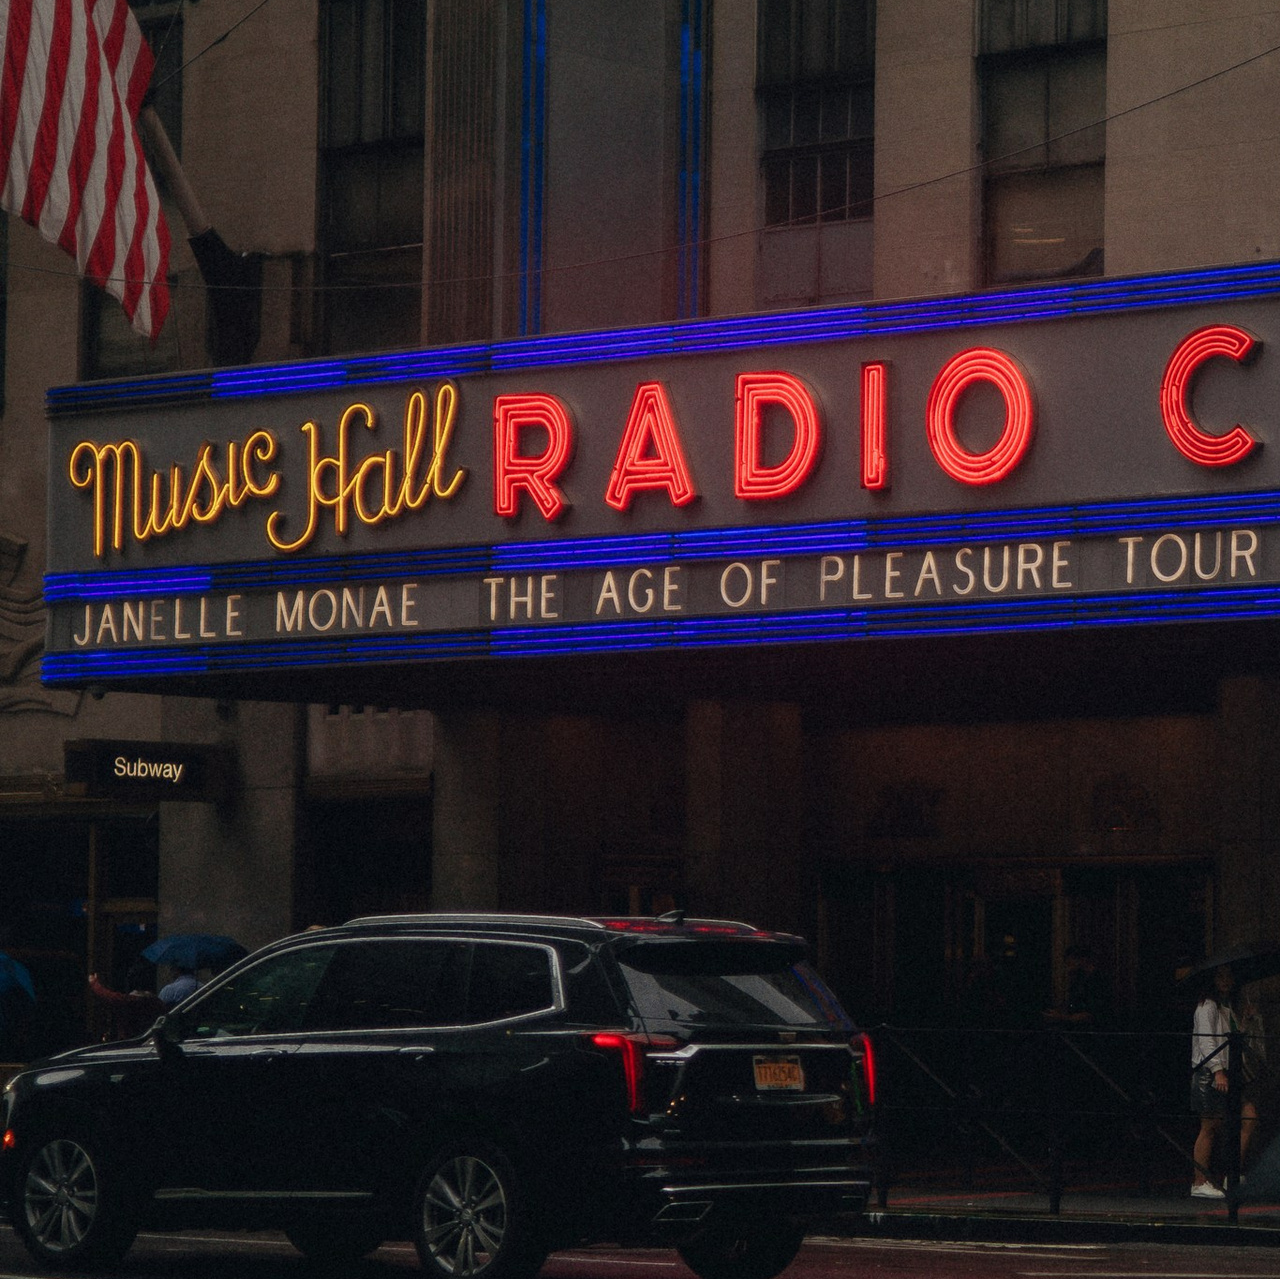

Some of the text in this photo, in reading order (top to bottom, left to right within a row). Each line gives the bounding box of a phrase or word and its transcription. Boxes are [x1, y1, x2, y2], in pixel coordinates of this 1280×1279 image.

[68, 379, 468, 557] Music Hall
[493, 347, 1036, 520] RADIO
[72, 594, 243, 646] JANELLE
[274, 582, 420, 632] MONAE
[482, 573, 560, 621] THE
[594, 565, 683, 614] AGE
[718, 558, 781, 608] OF
[819, 540, 1073, 602] PLEASURE
[1117, 529, 1259, 584] TOUR
[113, 756, 184, 783] Subway
